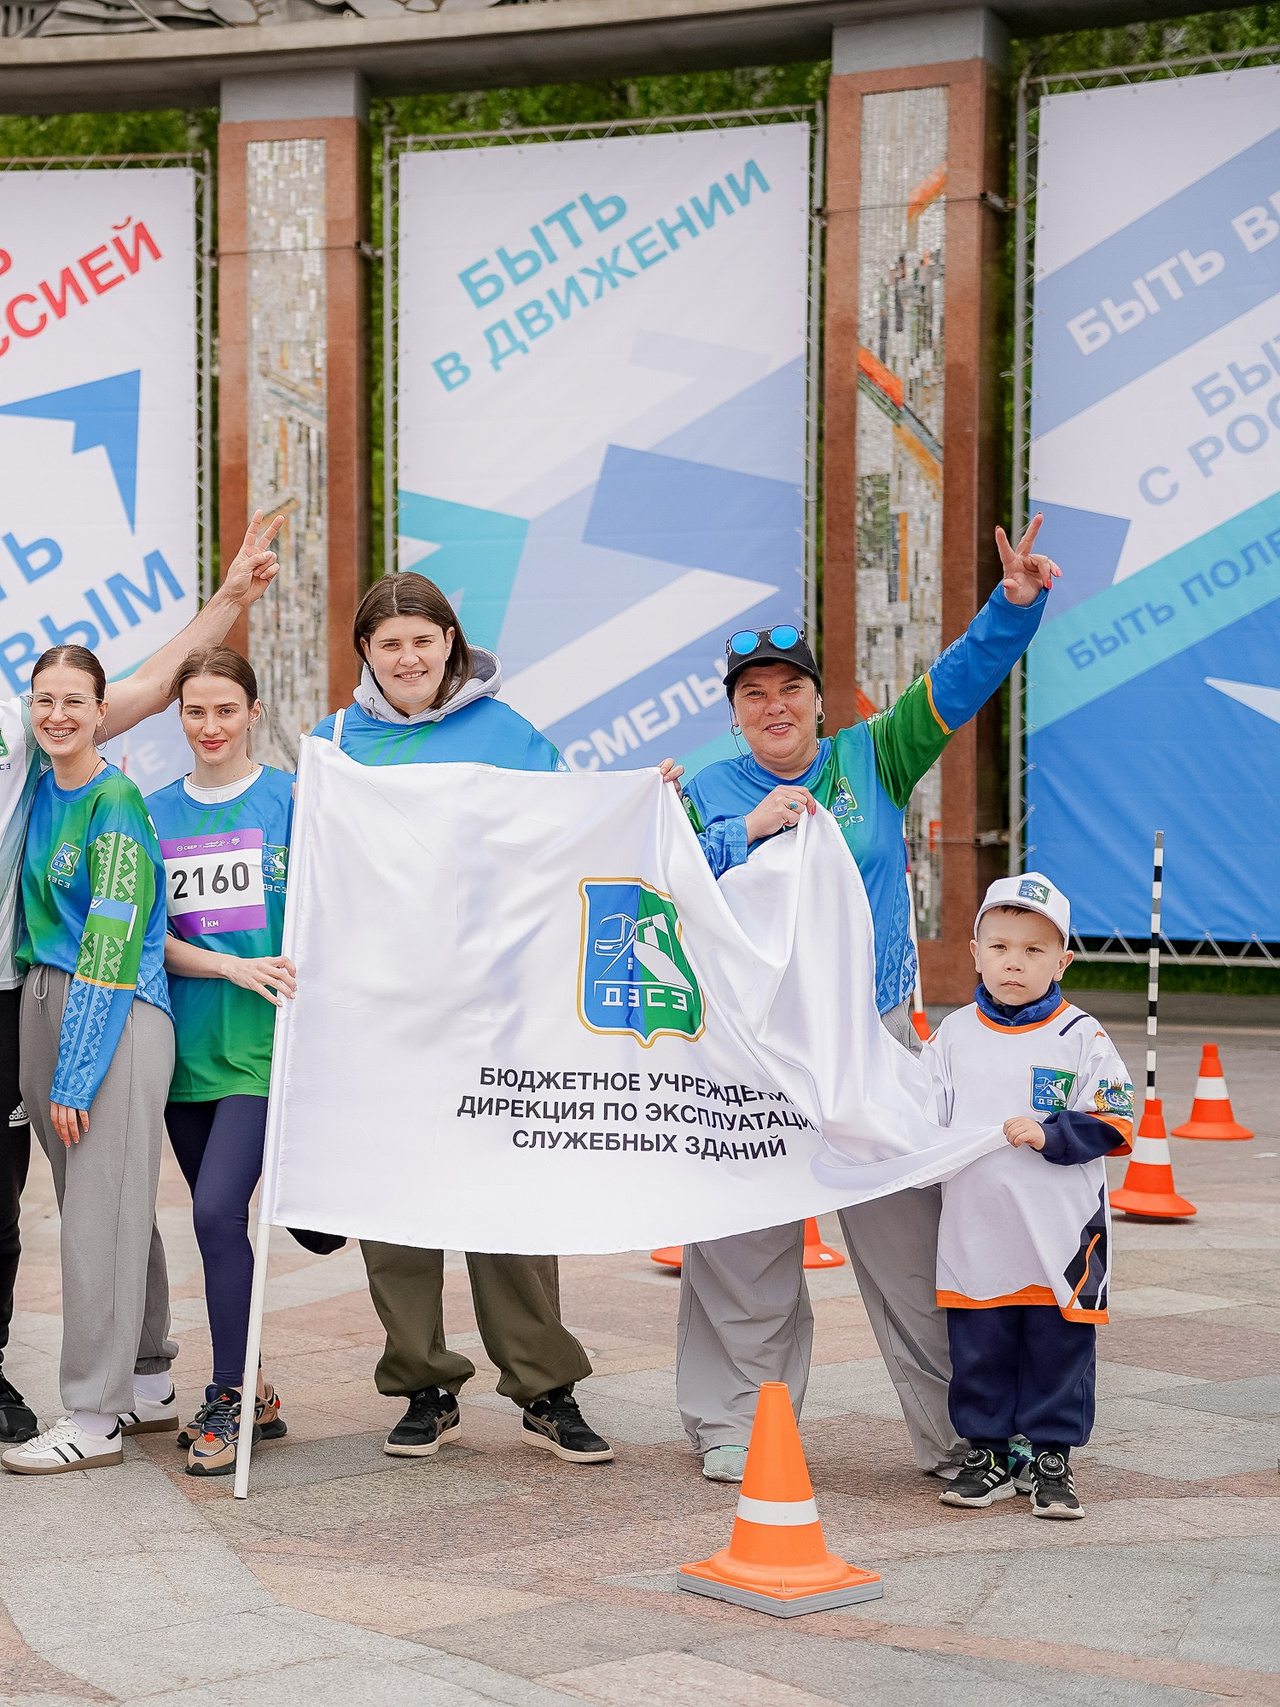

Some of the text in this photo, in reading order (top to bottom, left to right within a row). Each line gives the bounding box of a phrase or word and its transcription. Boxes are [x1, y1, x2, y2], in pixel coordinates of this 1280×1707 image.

[431, 158, 771, 393] В ДВИЖЕНИИ
[458, 193, 628, 309] БЫТЬ
[1066, 246, 1225, 356] БЫТЬ
[1192, 334, 1280, 416] БЫ
[1138, 466, 1179, 505] С
[1066, 599, 1176, 670] БЫТЬ
[563, 658, 727, 771] СМЕЛЫ
[171, 861, 250, 900] 2160
[480, 1066, 640, 1092] БЮДЖЕТНОЕ
[457, 1095, 821, 1135] ДИРЕКЦИЯ ПО ЭКСПЛУАТАЦИ
[512, 1129, 787, 1162] СЛУЖЕБНЫХ ЗДАНИЙ
